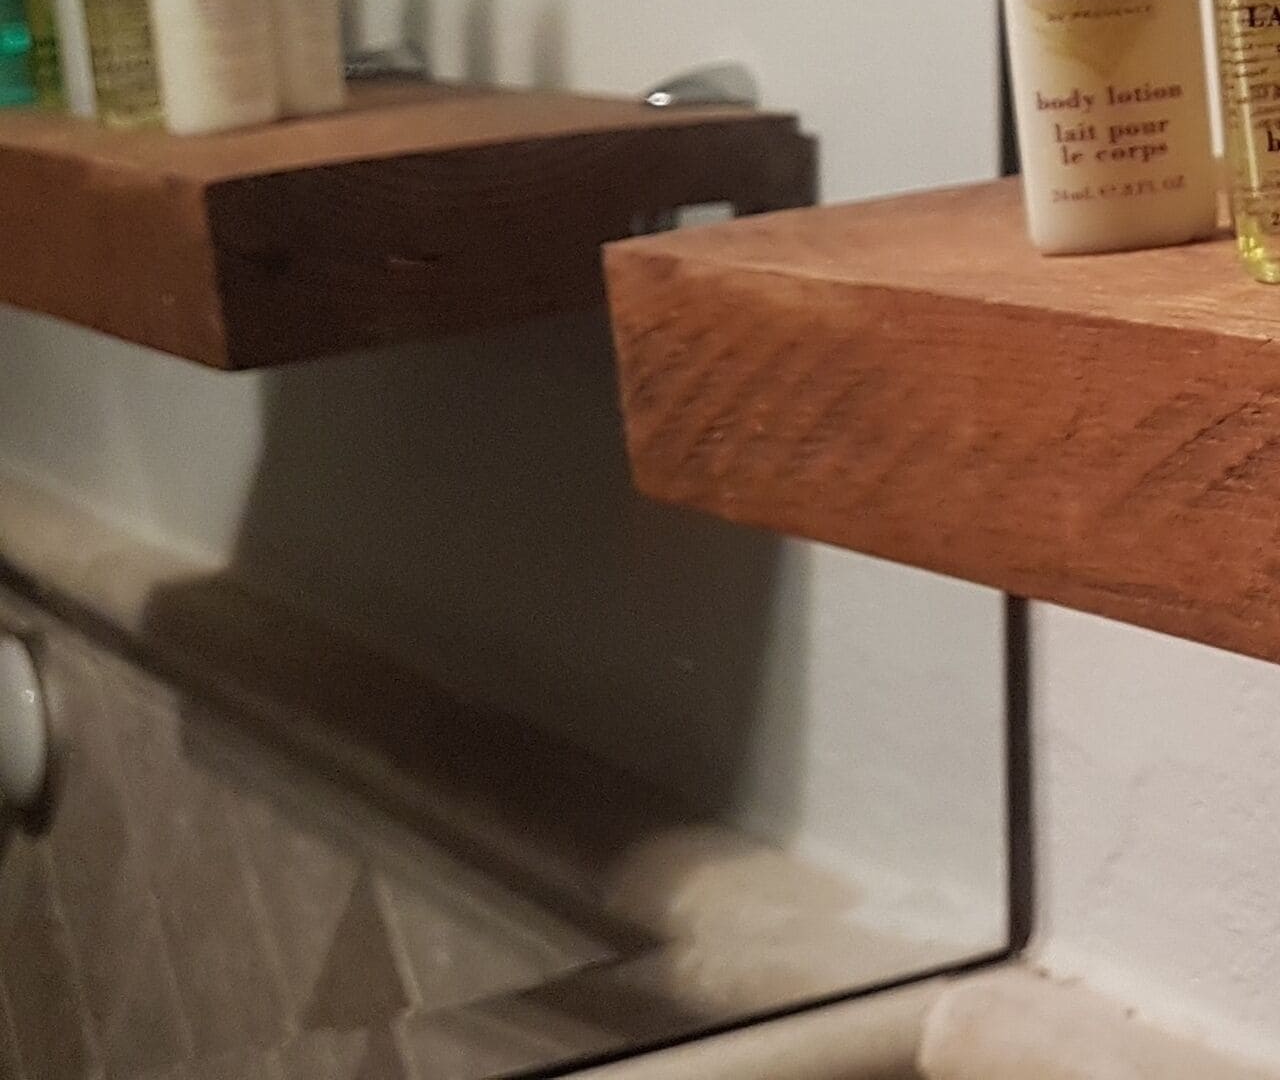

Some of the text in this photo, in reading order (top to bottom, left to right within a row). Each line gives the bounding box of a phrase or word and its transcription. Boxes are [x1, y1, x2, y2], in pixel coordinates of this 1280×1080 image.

[1036, 83, 1184, 113] body lotion
[1055, 120, 1168, 144] lait pour
[1061, 143, 1168, 165] le corps
